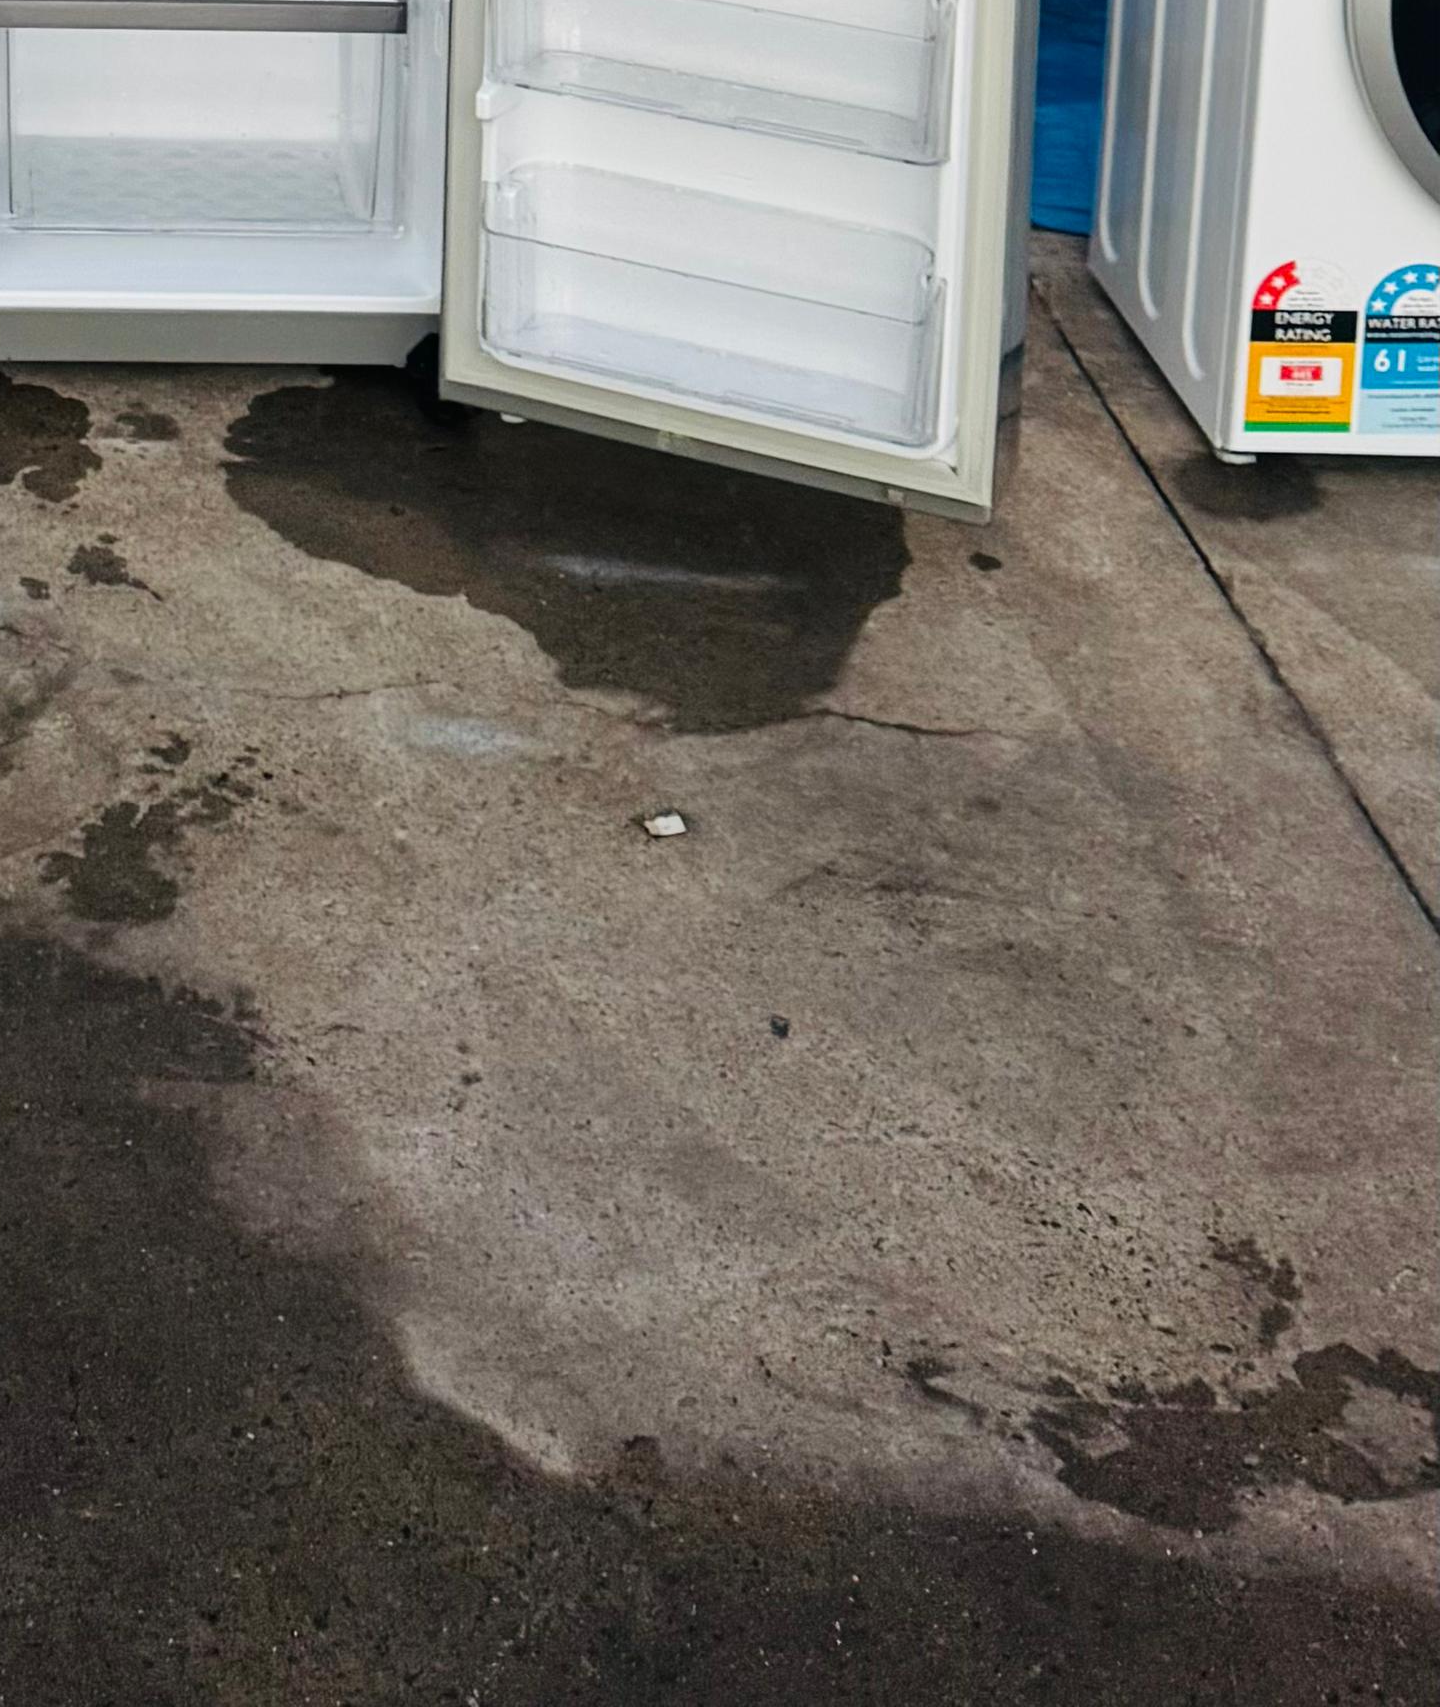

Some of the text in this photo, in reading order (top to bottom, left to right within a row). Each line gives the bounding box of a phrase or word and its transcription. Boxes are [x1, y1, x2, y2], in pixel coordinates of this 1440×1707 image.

[1274, 312, 1334, 325] ENERGY
[1367, 317, 1417, 329] WATER
[1274, 328, 1332, 342] RATING
[1373, 348, 1407, 373] 61
